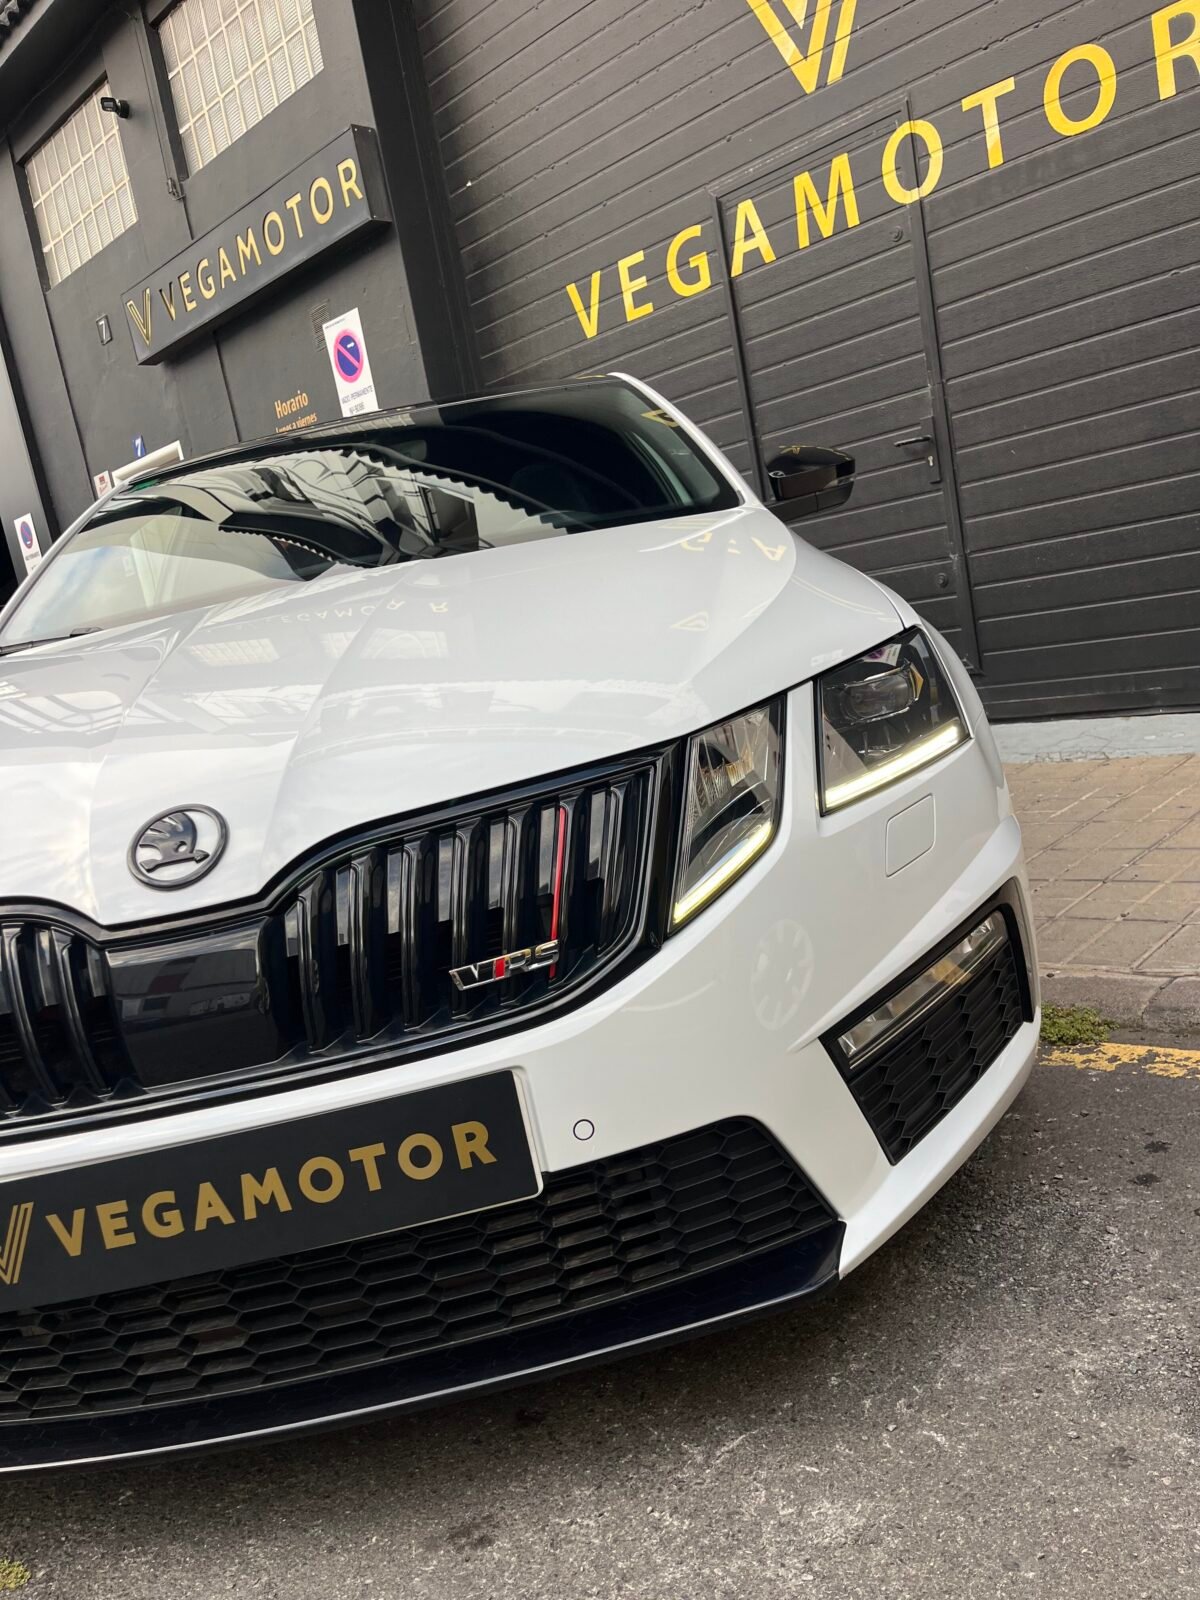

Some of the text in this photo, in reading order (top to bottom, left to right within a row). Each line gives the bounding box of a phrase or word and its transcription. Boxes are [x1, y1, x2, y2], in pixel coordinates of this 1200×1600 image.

[566, 0, 1200, 339] VEGAMOTOR
[159, 157, 364, 321] VEGAMOTOR
[274, 390, 309, 419] Horario
[296, 412, 318, 429] viernes
[45, 1119, 498, 1257] VEGAMOTOR
